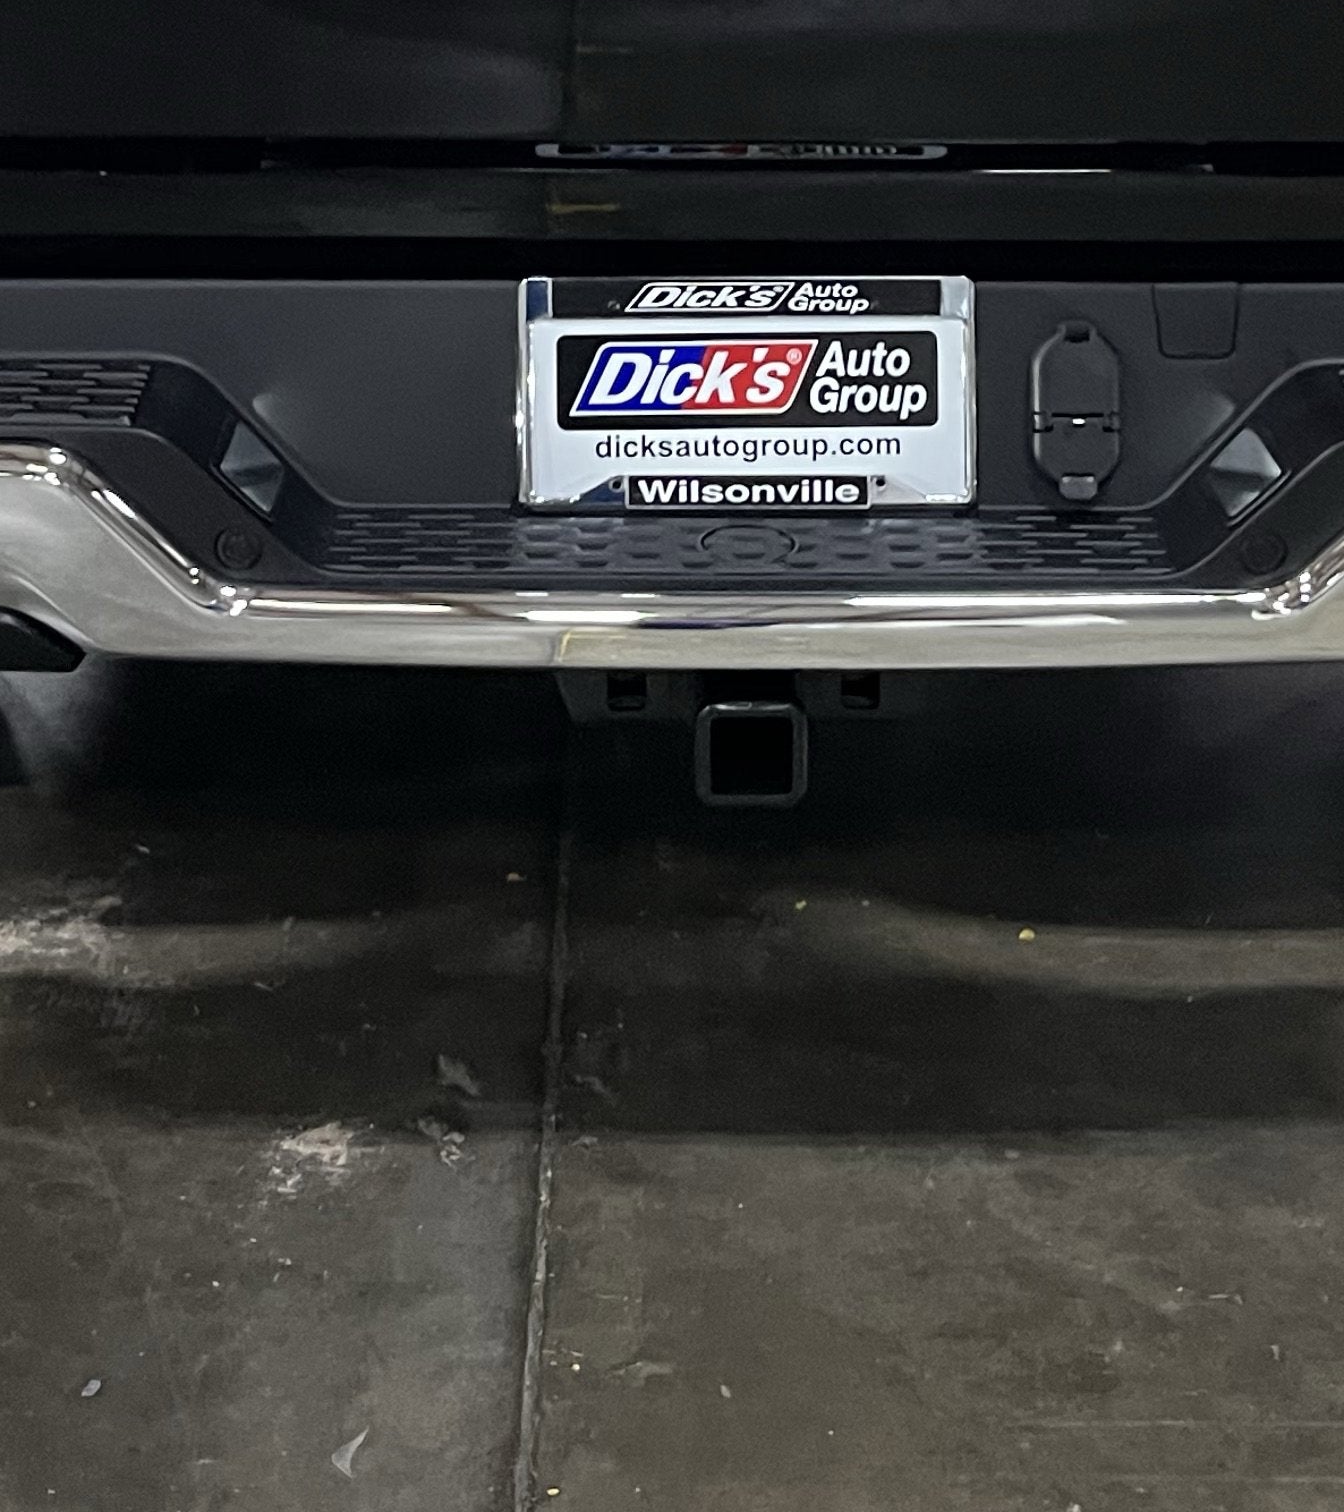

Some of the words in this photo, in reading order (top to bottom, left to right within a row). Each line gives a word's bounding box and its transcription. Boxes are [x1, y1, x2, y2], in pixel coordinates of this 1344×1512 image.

[795, 282, 858, 298] Auto
[787, 295, 871, 315] Group
[815, 340, 911, 378] Auto
[809, 376, 928, 420] Group
[595, 435, 902, 462] dicksautogroup.com
[637, 479, 860, 504] Wilsonville
